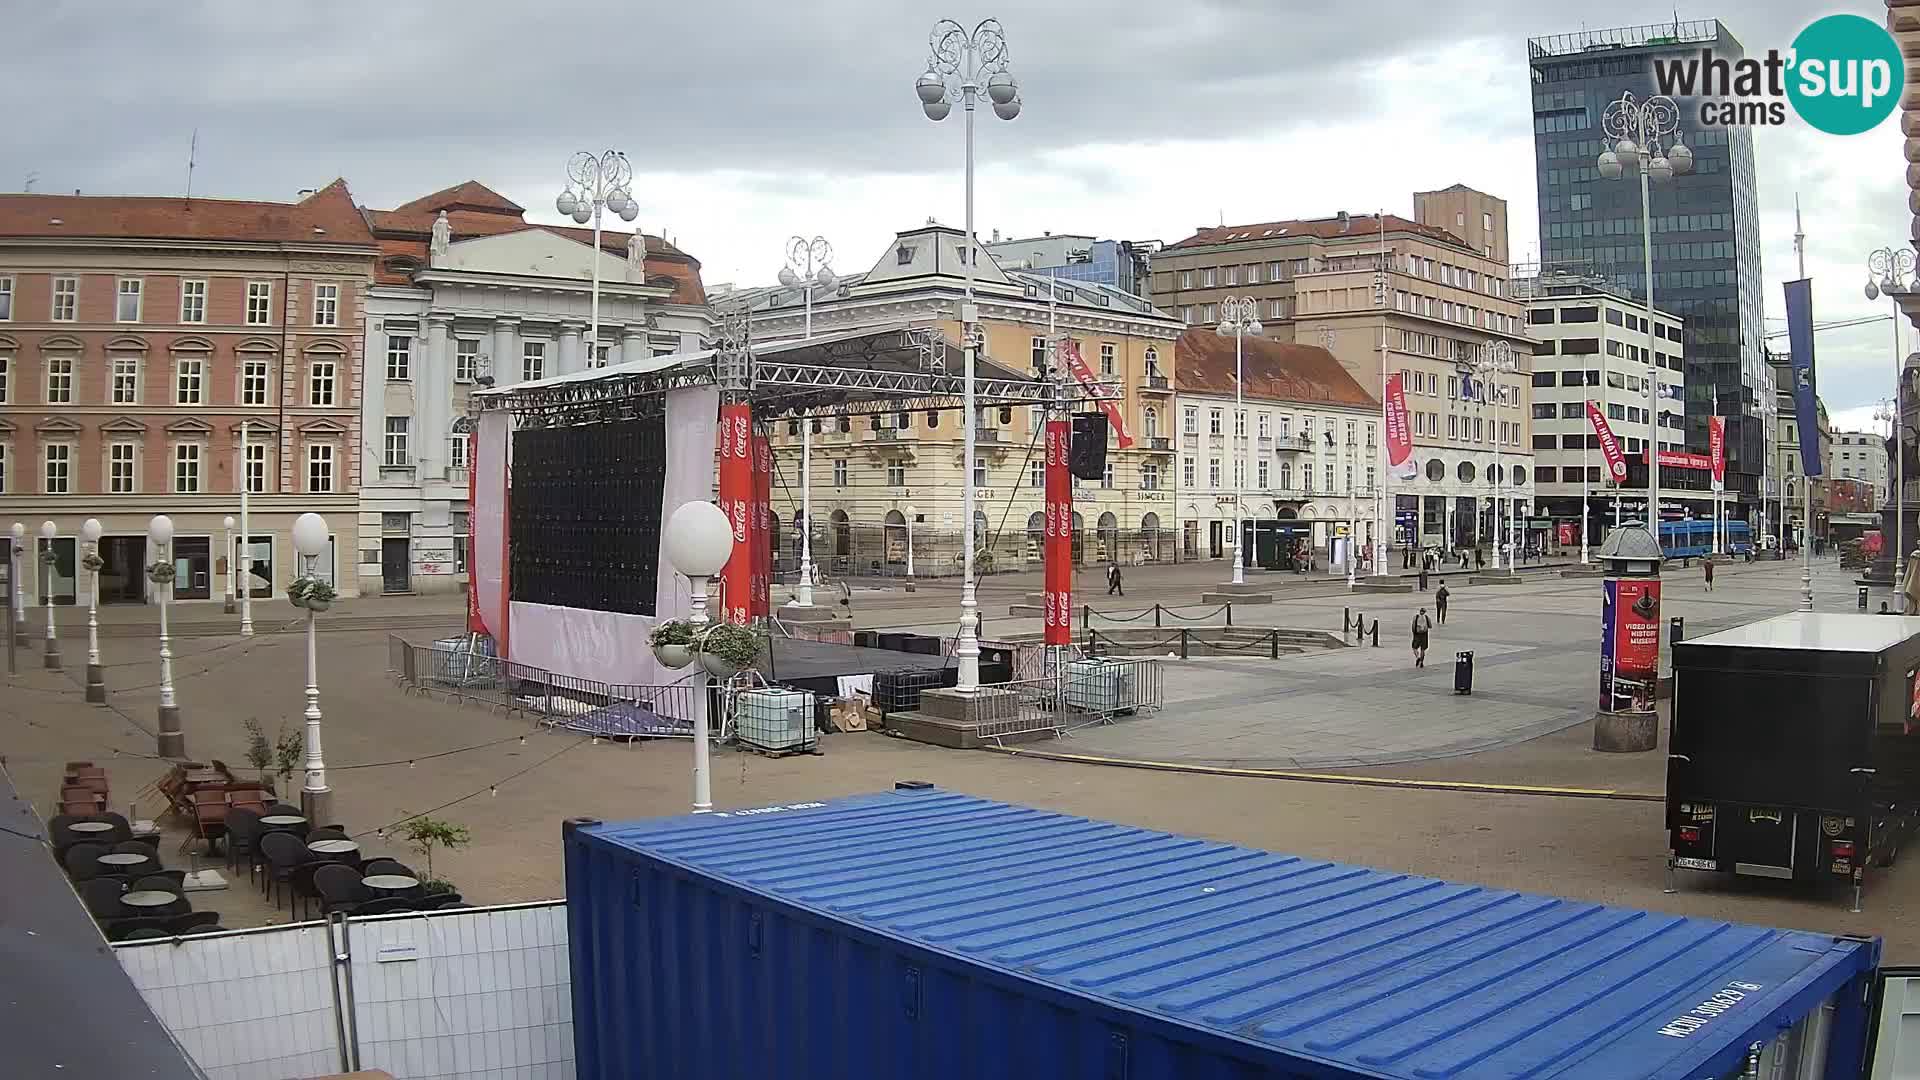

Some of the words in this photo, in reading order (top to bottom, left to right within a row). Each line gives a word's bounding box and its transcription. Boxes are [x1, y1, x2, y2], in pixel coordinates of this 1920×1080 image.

[1592, 412, 1601, 427] MI
[1599, 426, 1619, 461] HRVATI
[1690, 989, 1746, 1018] 300629
